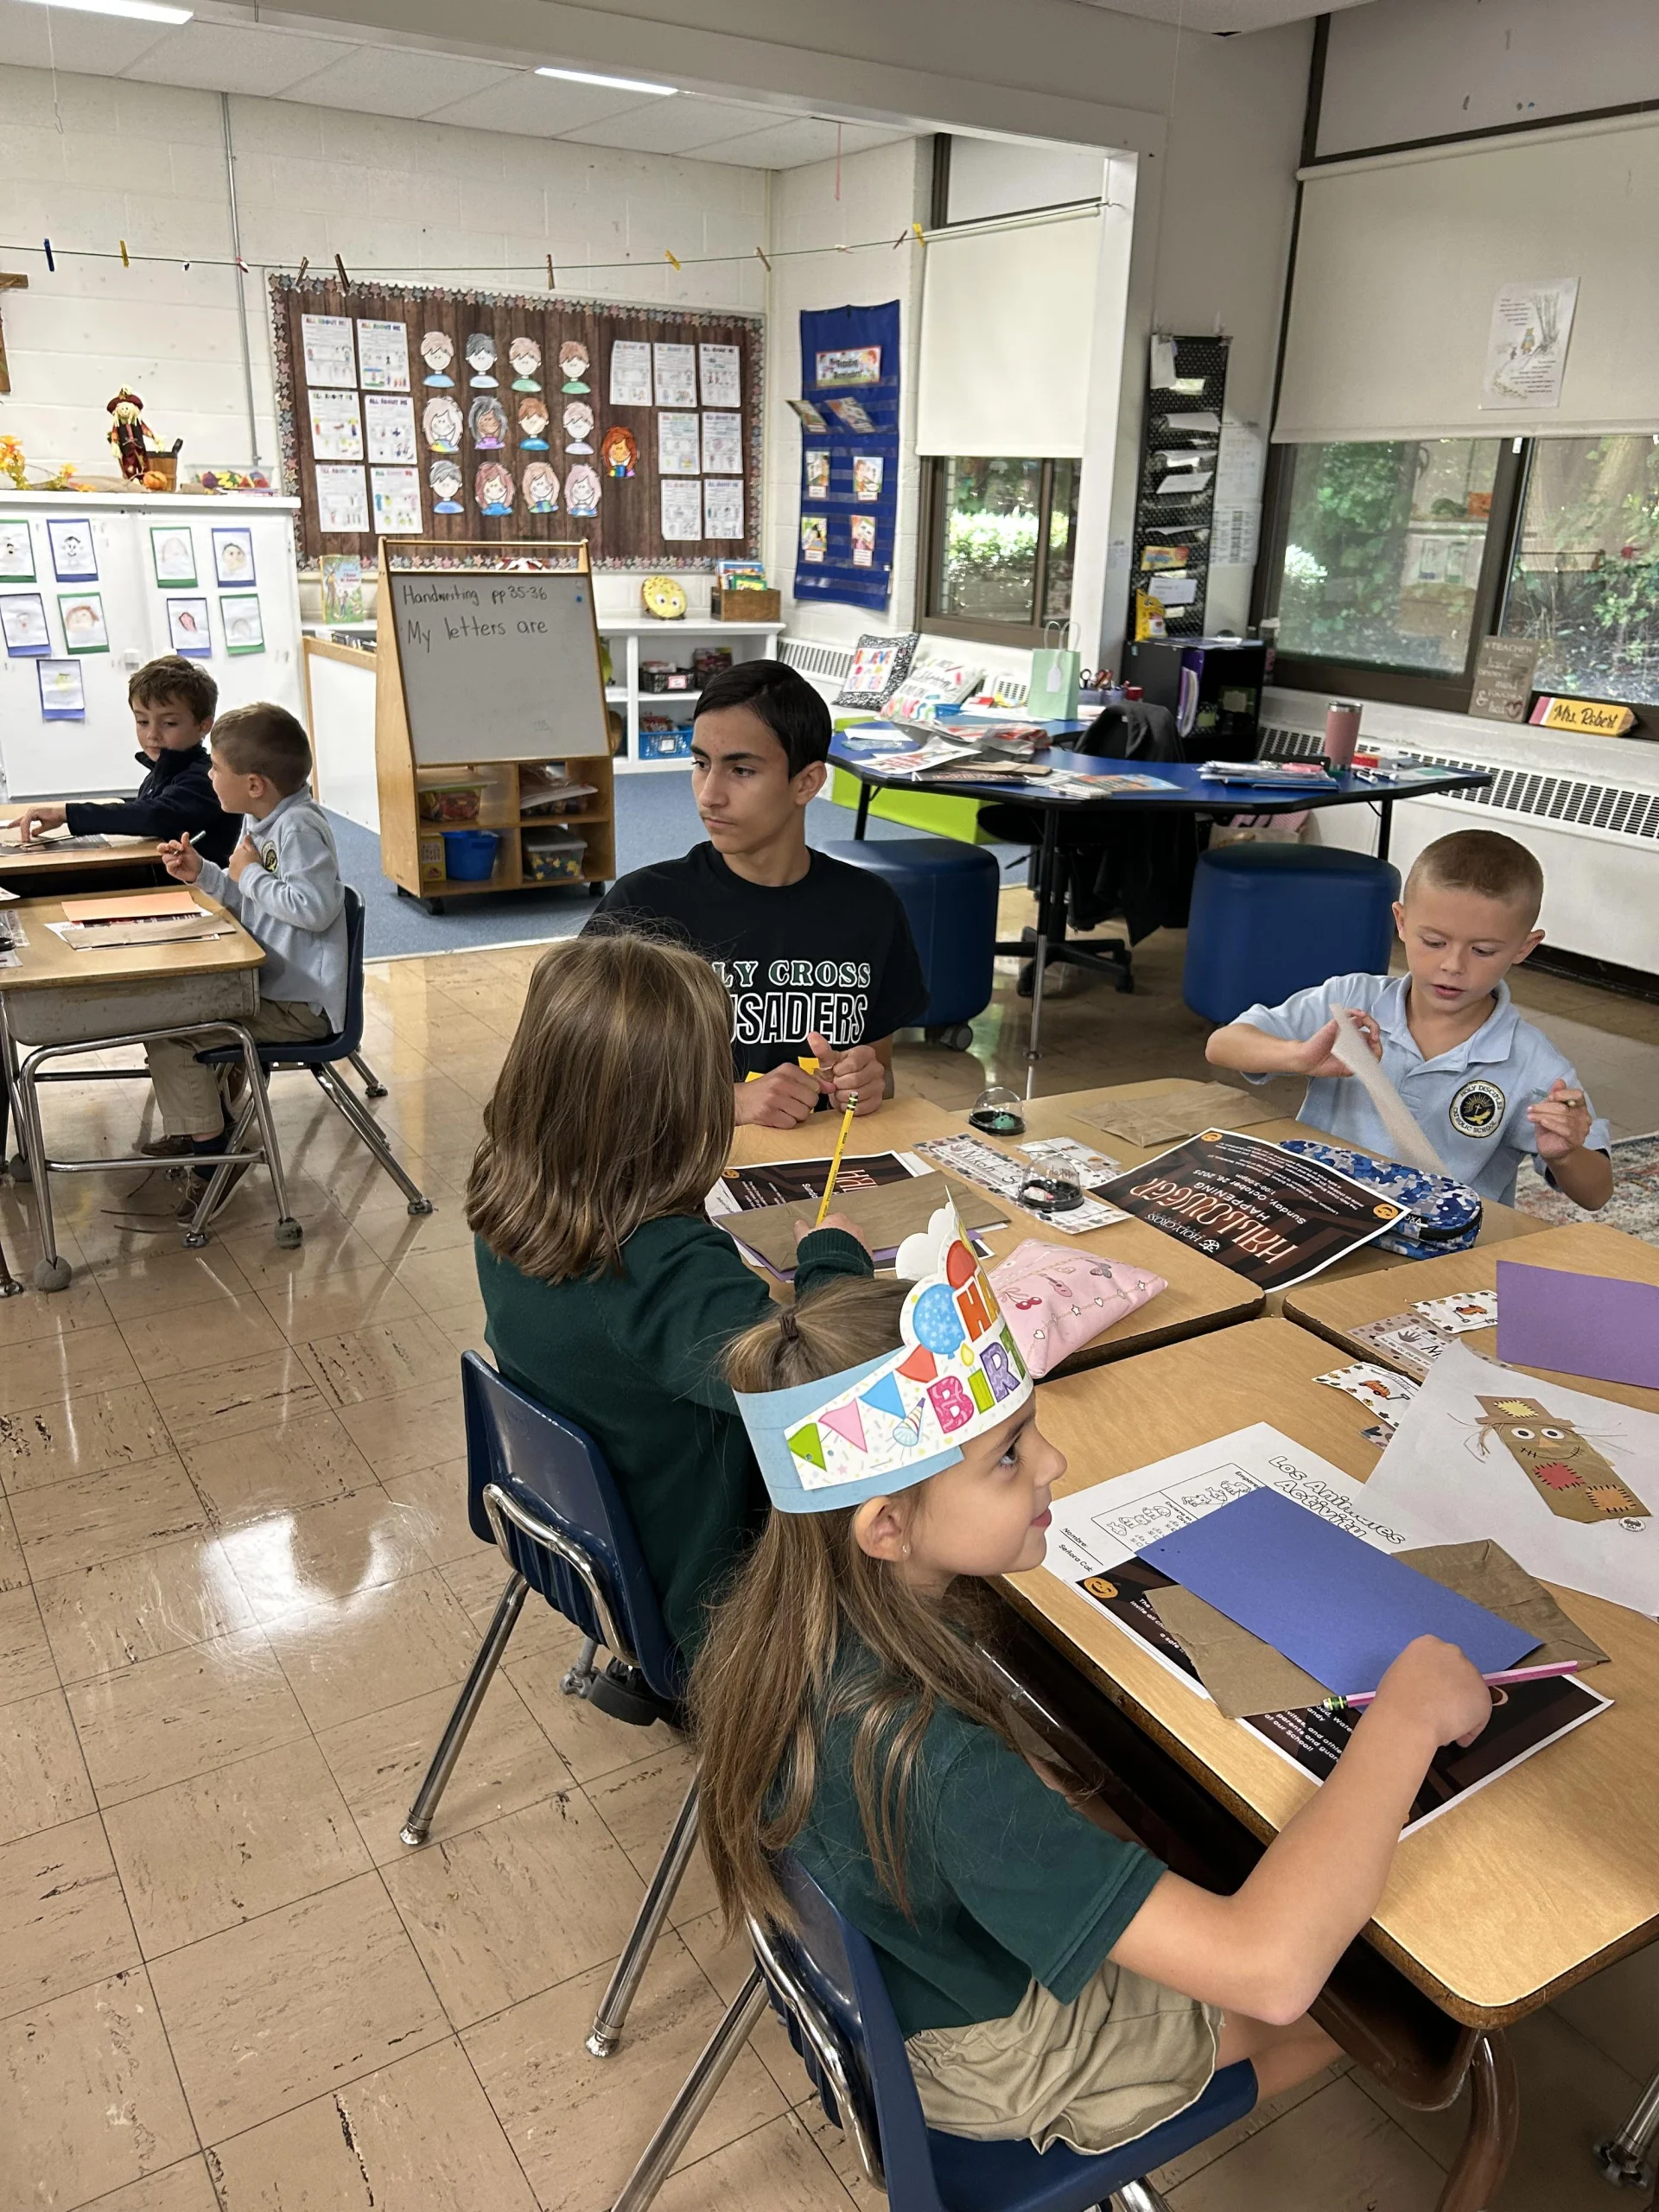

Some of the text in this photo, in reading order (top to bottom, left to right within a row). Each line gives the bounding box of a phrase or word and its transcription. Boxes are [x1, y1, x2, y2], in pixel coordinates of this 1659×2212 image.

[403, 584, 480, 607] Handwriting
[407, 615, 549, 653] My letters are
[712, 959, 871, 988] LY CROSS
[730, 991, 868, 1045] SADERS
[1459, 1085, 1477, 1097] HOLY
[1452, 1106, 1497, 1134] CATHOLIC SCHOOL
[1192, 1167, 1216, 1179] 2025
[1192, 1180, 1270, 1220] HAPPENING
[1227, 1179, 1267, 1201] October
[1128, 1175, 1298, 1264] HALLOWEEN
[1268, 1198, 1306, 1224] Sunday,
[1144, 1211, 1202, 1243] HOLY CROSS
[1267, 1455, 1307, 1482] Los
[1164, 1500, 1185, 1516] Encierra
[1062, 1527, 1088, 1548] Nombre:
[1058, 1543, 1081, 1562] Señora
[1128, 1599, 1147, 1614] invite
[1138, 1598, 1151, 1608] The
[1163, 1637, 1179, 1649] safe
[1306, 1706, 1326, 1721] andy
[1315, 1704, 1354, 1733] oad, Wate
[1263, 1713, 1314, 1752] at our School!
[1274, 1712, 1339, 1763] parents and guar
[1306, 1726, 1324, 1739] and
[1321, 1737, 1343, 1754] athle
